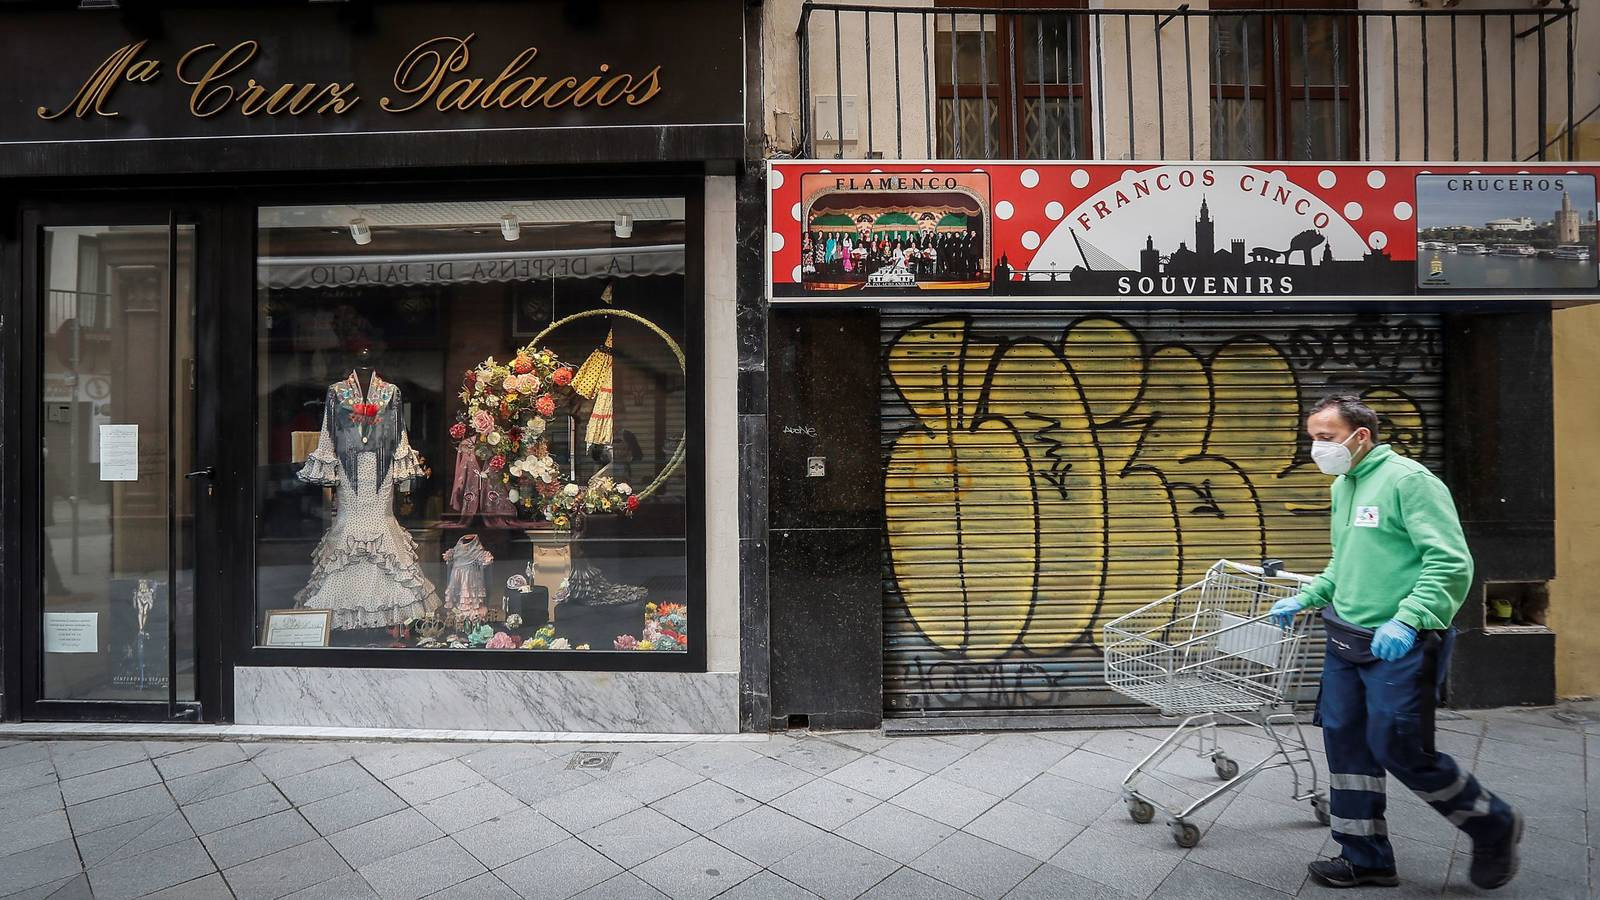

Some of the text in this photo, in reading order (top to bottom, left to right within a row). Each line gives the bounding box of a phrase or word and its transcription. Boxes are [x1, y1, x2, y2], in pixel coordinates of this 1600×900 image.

[176, 40, 360, 117] Cruz
[379, 32, 662, 113] Palacios
[835, 177, 958, 191] FLAMENCO
[1447, 179, 1564, 191] CRUCEROS
[1077, 169, 1330, 232] FRANCOS CINCO
[1117, 275, 1294, 295] SOUVENIRS
